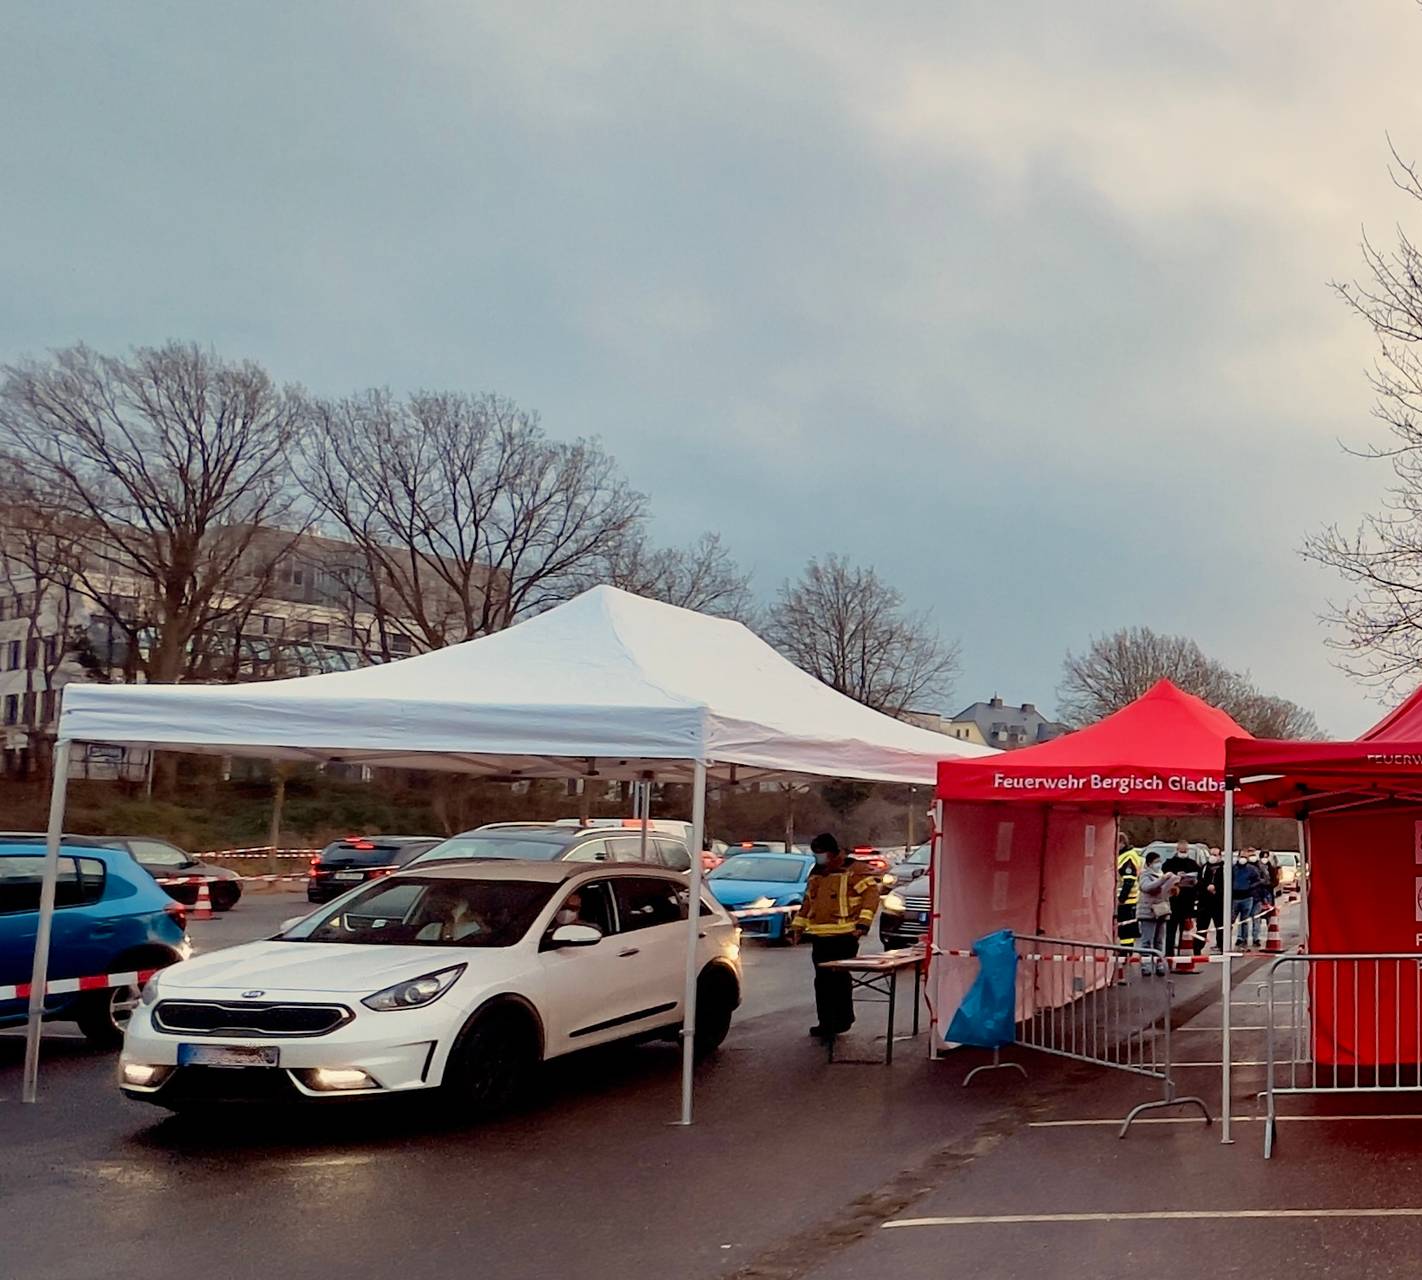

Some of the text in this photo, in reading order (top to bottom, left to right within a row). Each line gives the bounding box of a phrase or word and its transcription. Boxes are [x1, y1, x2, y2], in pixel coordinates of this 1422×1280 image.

[993, 773, 1241, 794] Feuerwehr Bergisch Gladba
